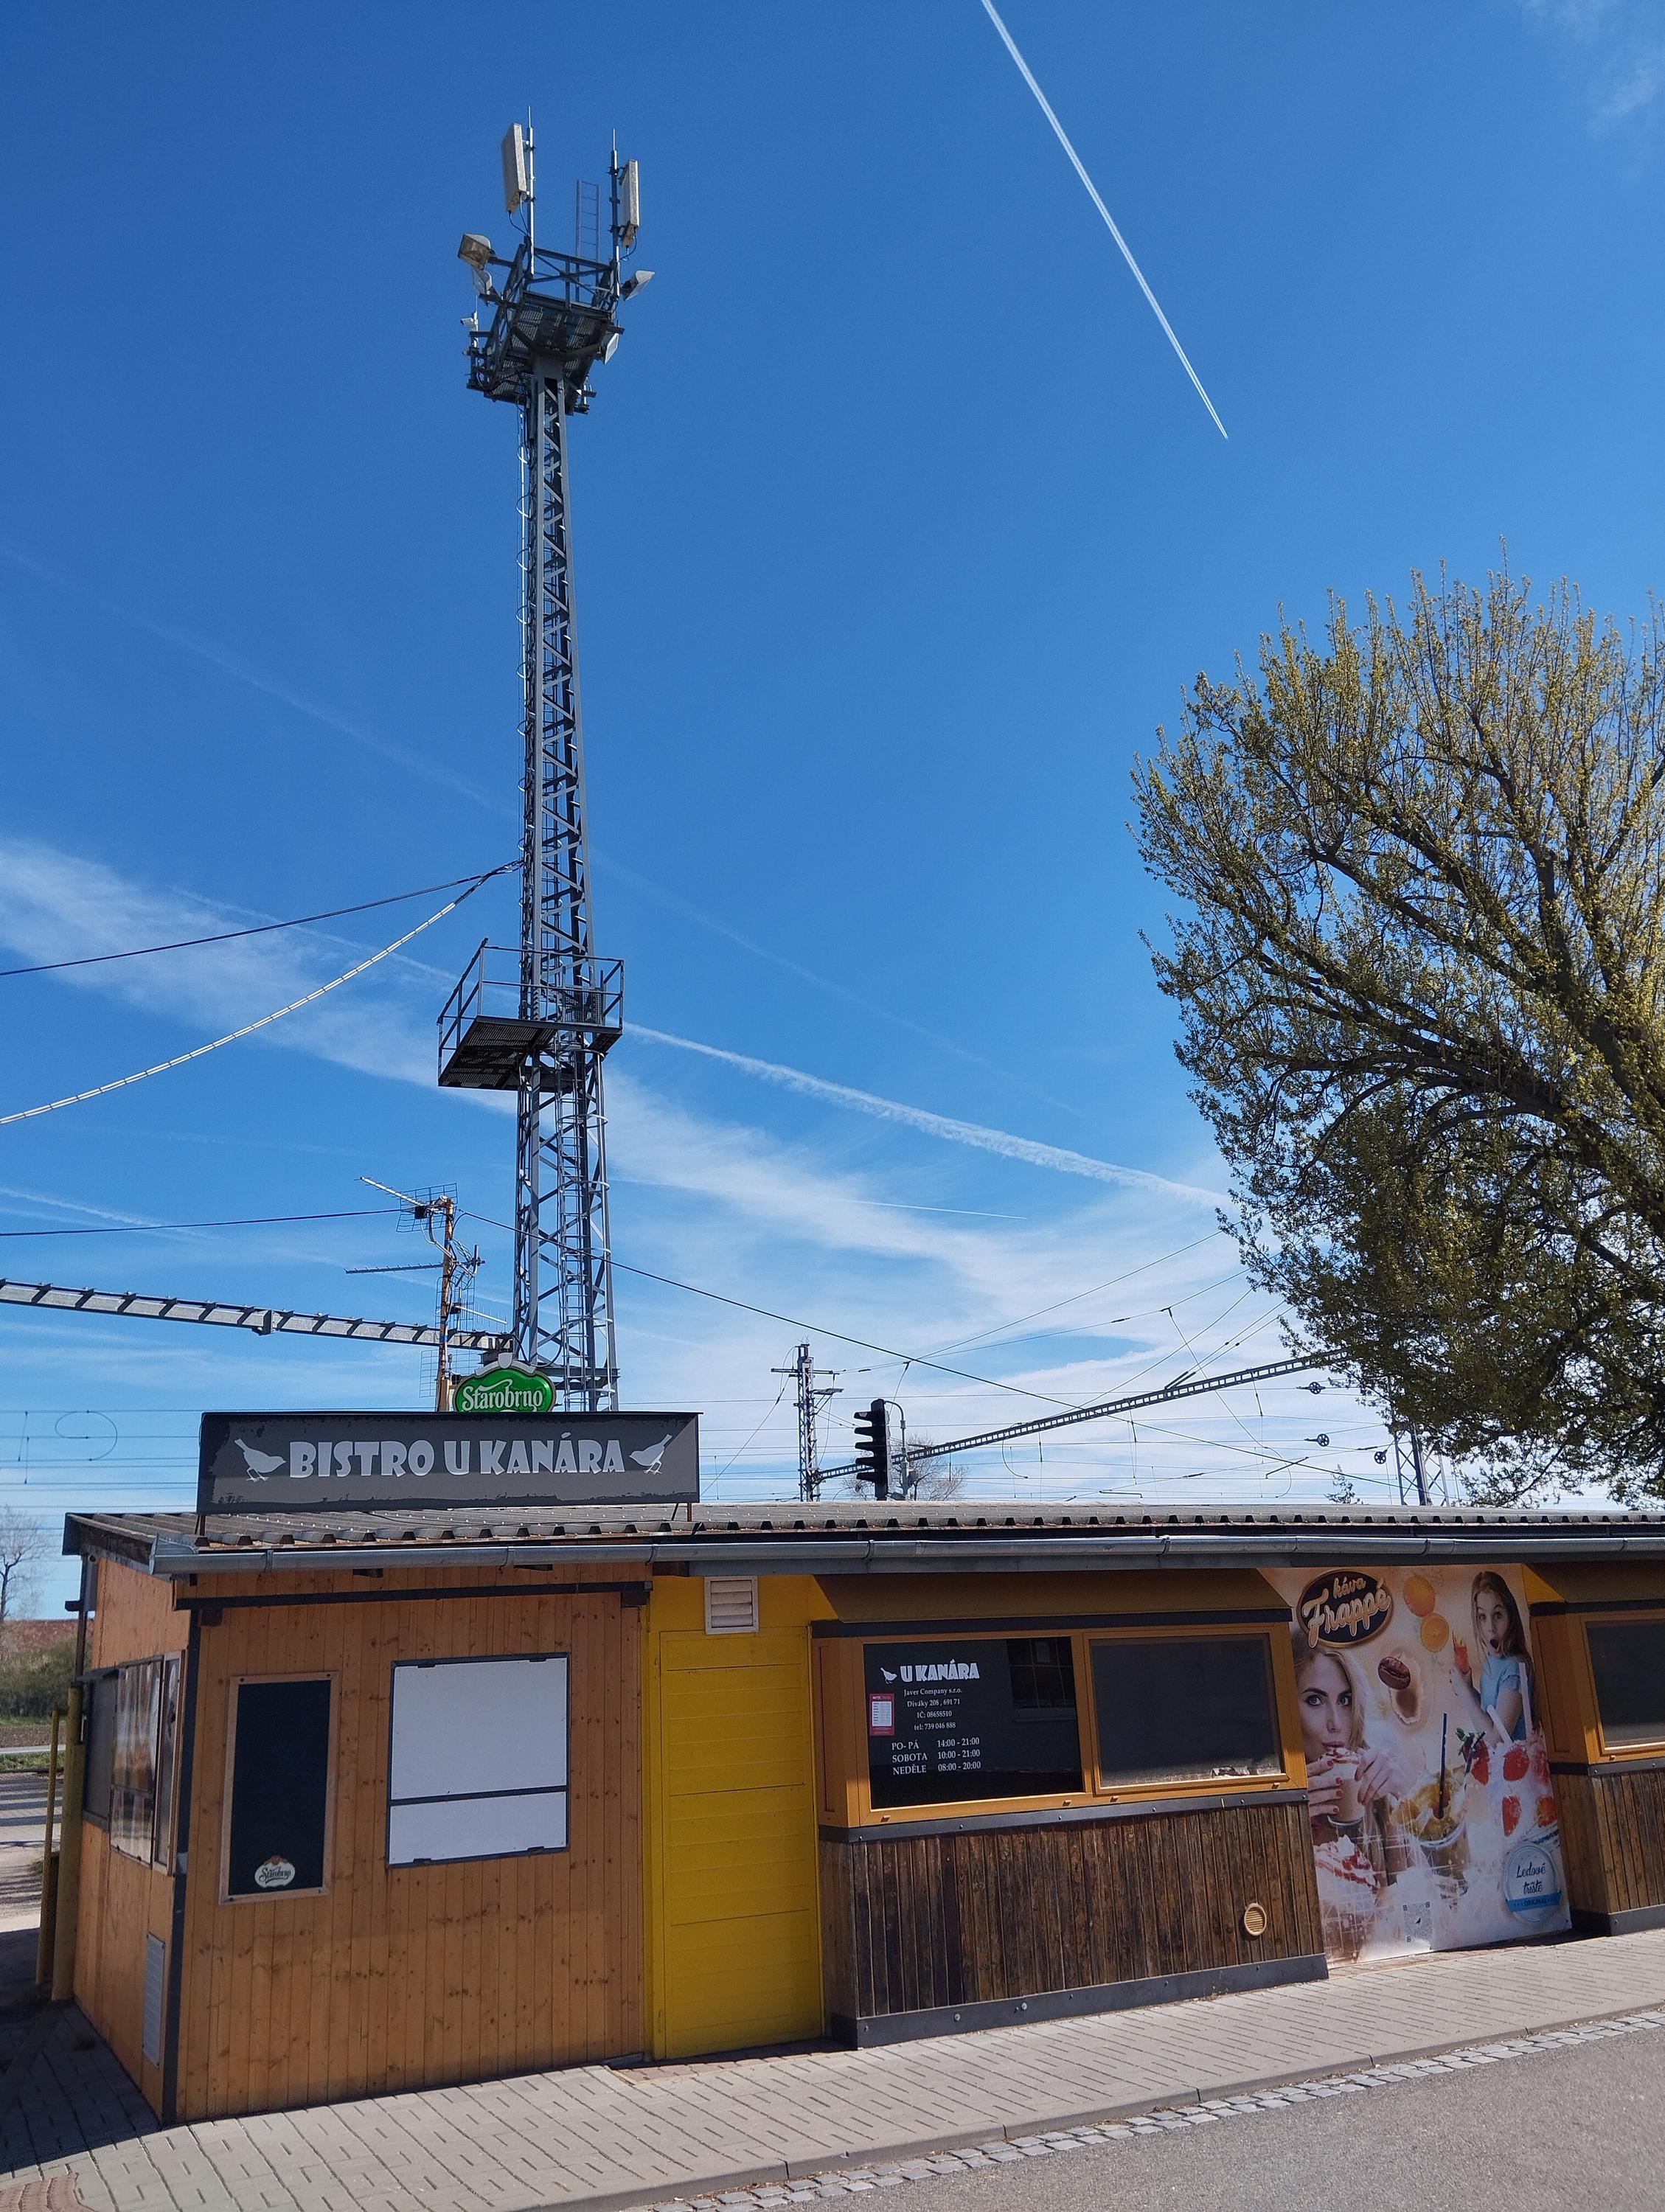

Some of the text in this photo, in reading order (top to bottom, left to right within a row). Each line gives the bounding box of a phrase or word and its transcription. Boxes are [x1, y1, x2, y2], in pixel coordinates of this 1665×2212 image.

[462, 1378, 543, 1412] Starobrno
[290, 1432, 625, 1478] BISTRO U KANÁRA
[1333, 1576, 1366, 1599] káva
[1302, 1578, 1391, 1648] Frappé
[900, 1658, 980, 1683] U KANÁRA
[920, 1688, 948, 1696] Company
[908, 1739, 920, 1750] PÁ
[936, 1739, 956, 1747] 14:00
[961, 1736, 980, 1746] 21:00
[892, 1753, 928, 1763] SOBOTA
[937, 1750, 956, 1759] 10:00
[962, 1749, 981, 1758] 21:00
[892, 1763, 927, 1775] NEDĚLE
[937, 1762, 957, 1772] 08:00
[962, 1761, 981, 1770] 20:00
